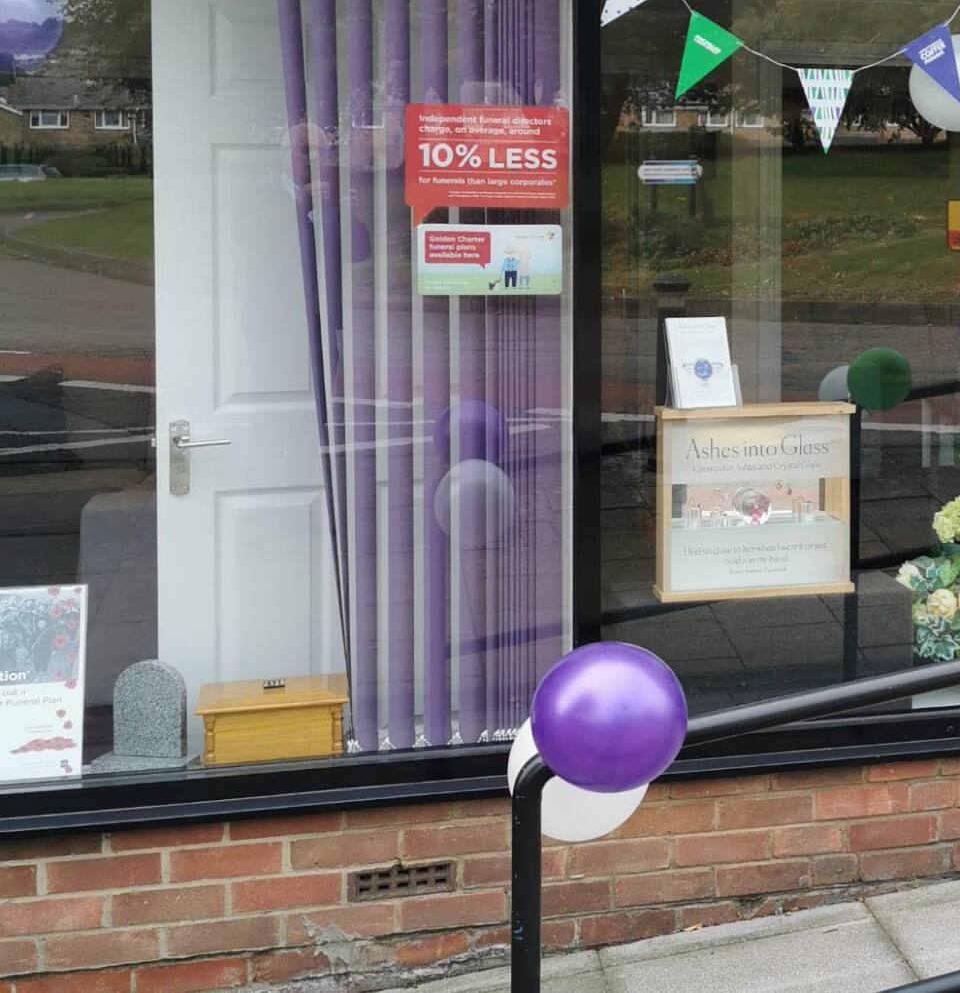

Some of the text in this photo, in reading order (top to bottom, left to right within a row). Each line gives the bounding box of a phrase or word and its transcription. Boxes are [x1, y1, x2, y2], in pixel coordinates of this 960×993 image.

[418, 114, 552, 126] Independent funeral directors
[418, 126, 453, 135] charge,
[469, 127, 507, 136] average,
[509, 127, 541, 136] around
[418, 142, 558, 169] 10% LESS
[418, 176, 431, 185] for
[432, 177, 466, 185] funerals
[466, 178, 486, 186] than
[487, 178, 509, 187] large
[428, 235, 486, 243] Golden Charter
[428, 243, 456, 251] funeral
[685, 433, 830, 460] Ashes into Glass
[6, 697, 41, 707] Funeral
[42, 696, 63, 705] Plan
